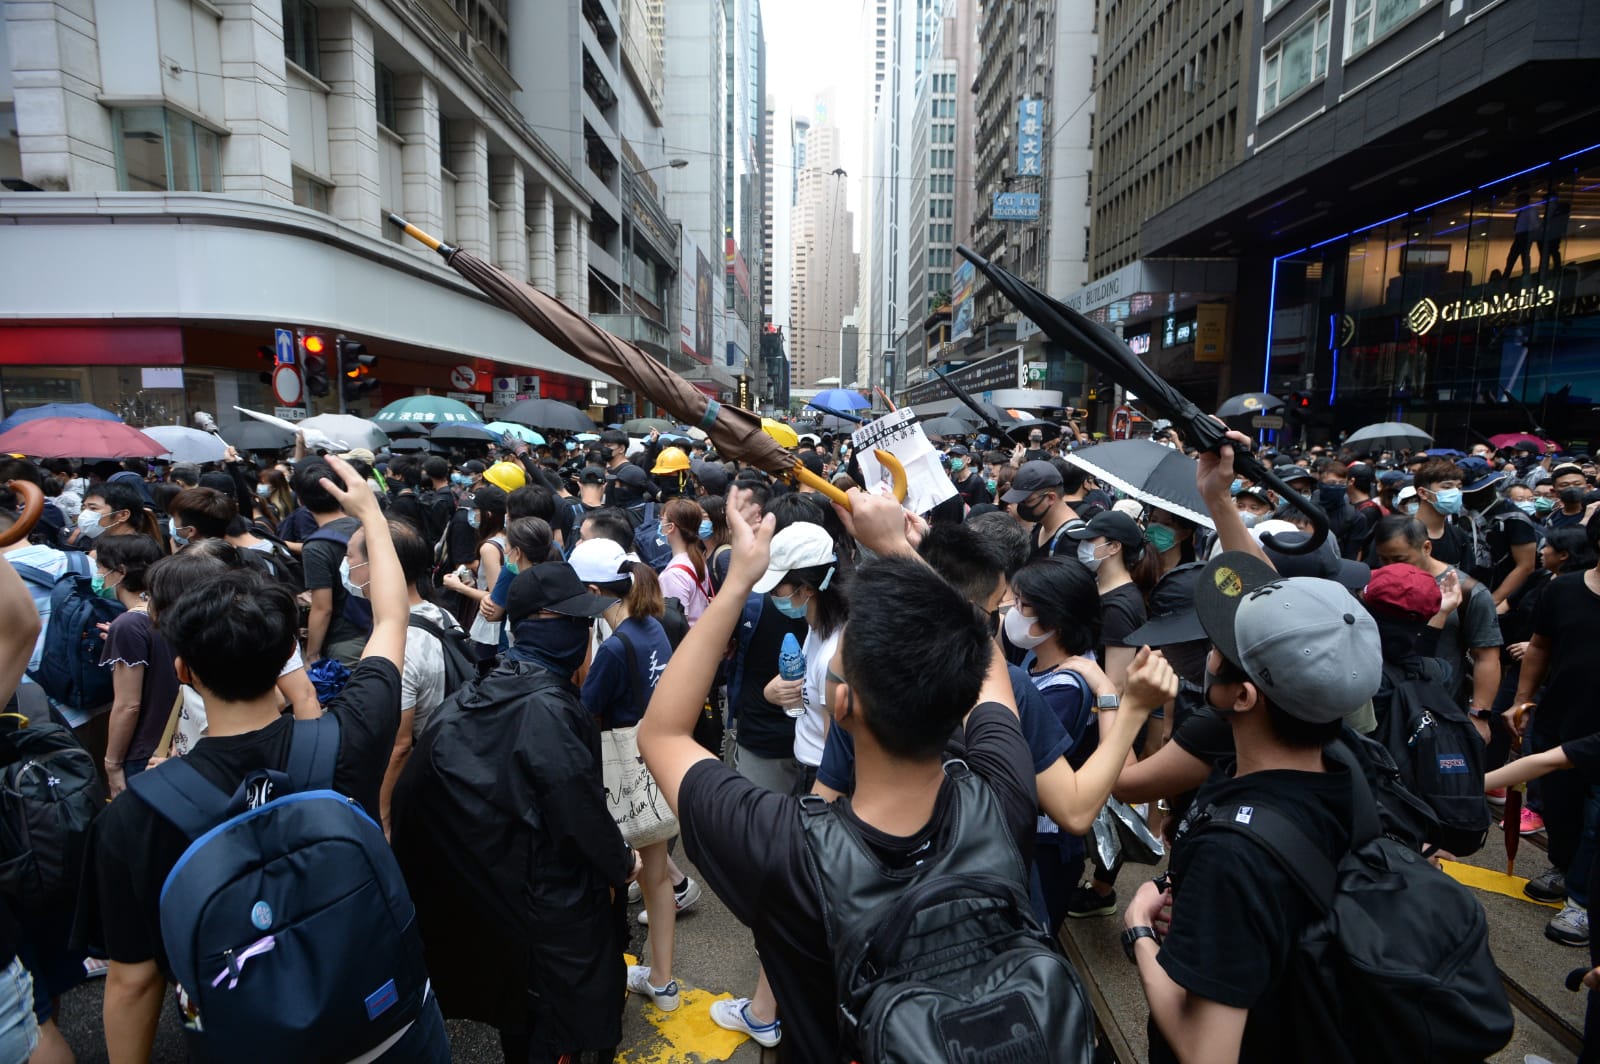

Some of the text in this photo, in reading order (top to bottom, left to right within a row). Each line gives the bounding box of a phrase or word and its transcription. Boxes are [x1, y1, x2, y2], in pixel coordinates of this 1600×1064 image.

[998, 197, 1036, 206] YAT FAT
[1086, 278, 1119, 306] BUILDING
[1441, 284, 1554, 322] China Mobile
